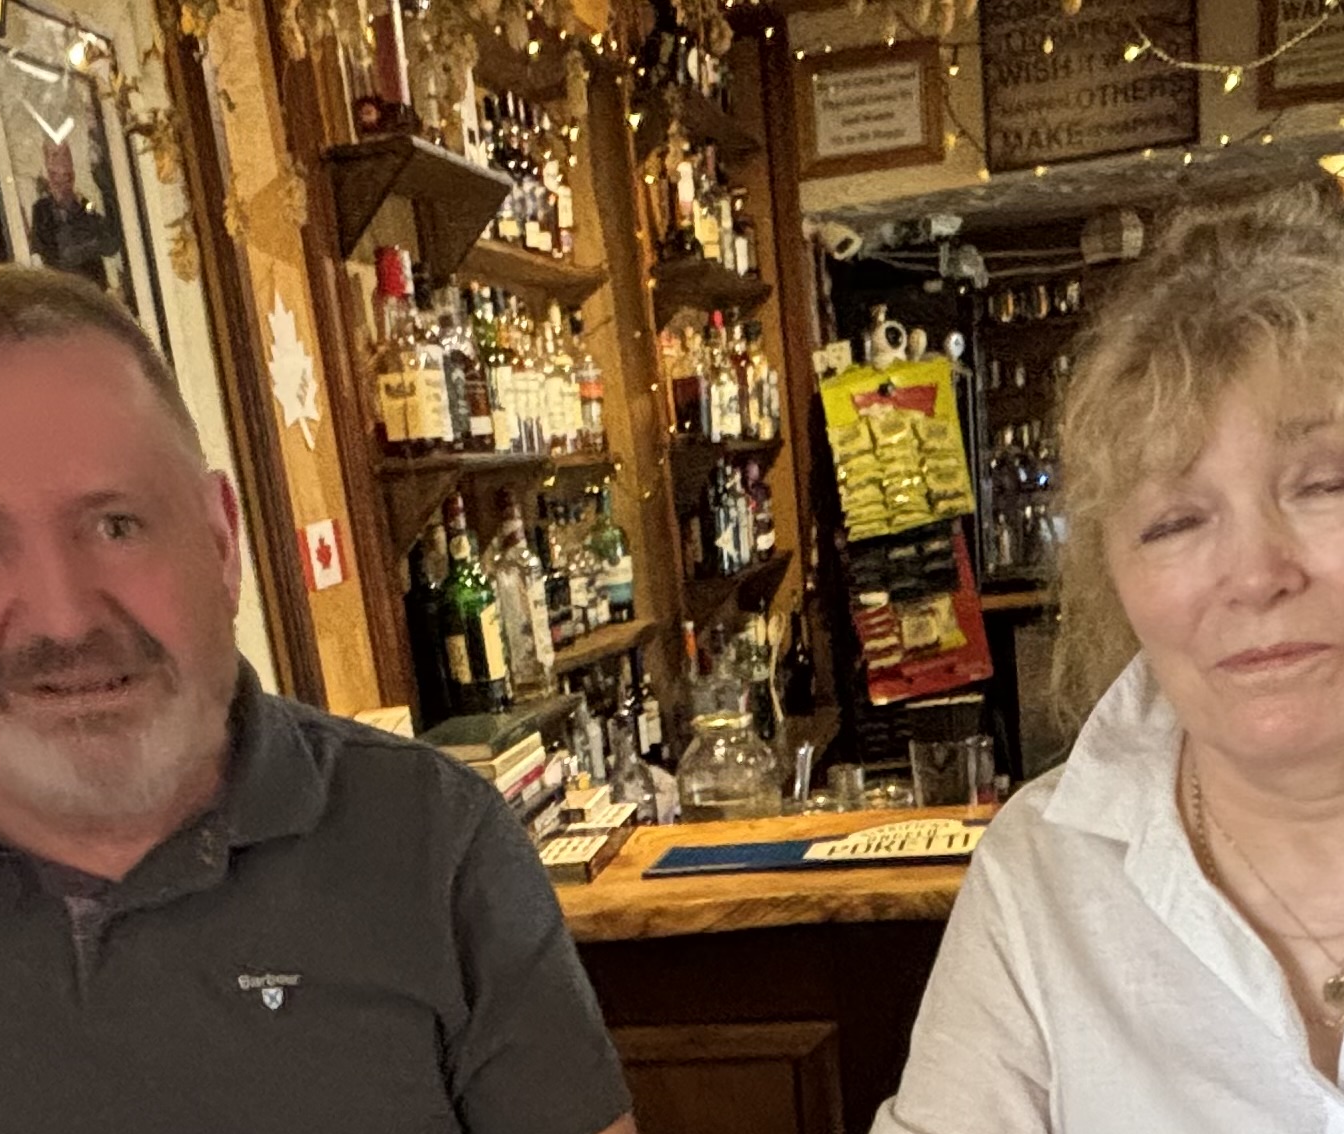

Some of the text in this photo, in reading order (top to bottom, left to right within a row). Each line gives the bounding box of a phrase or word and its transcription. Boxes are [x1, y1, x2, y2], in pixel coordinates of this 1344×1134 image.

[996, 54, 1072, 88] WISH
[1077, 72, 1189, 109] OTHERS
[999, 121, 1084, 152] MAKE
